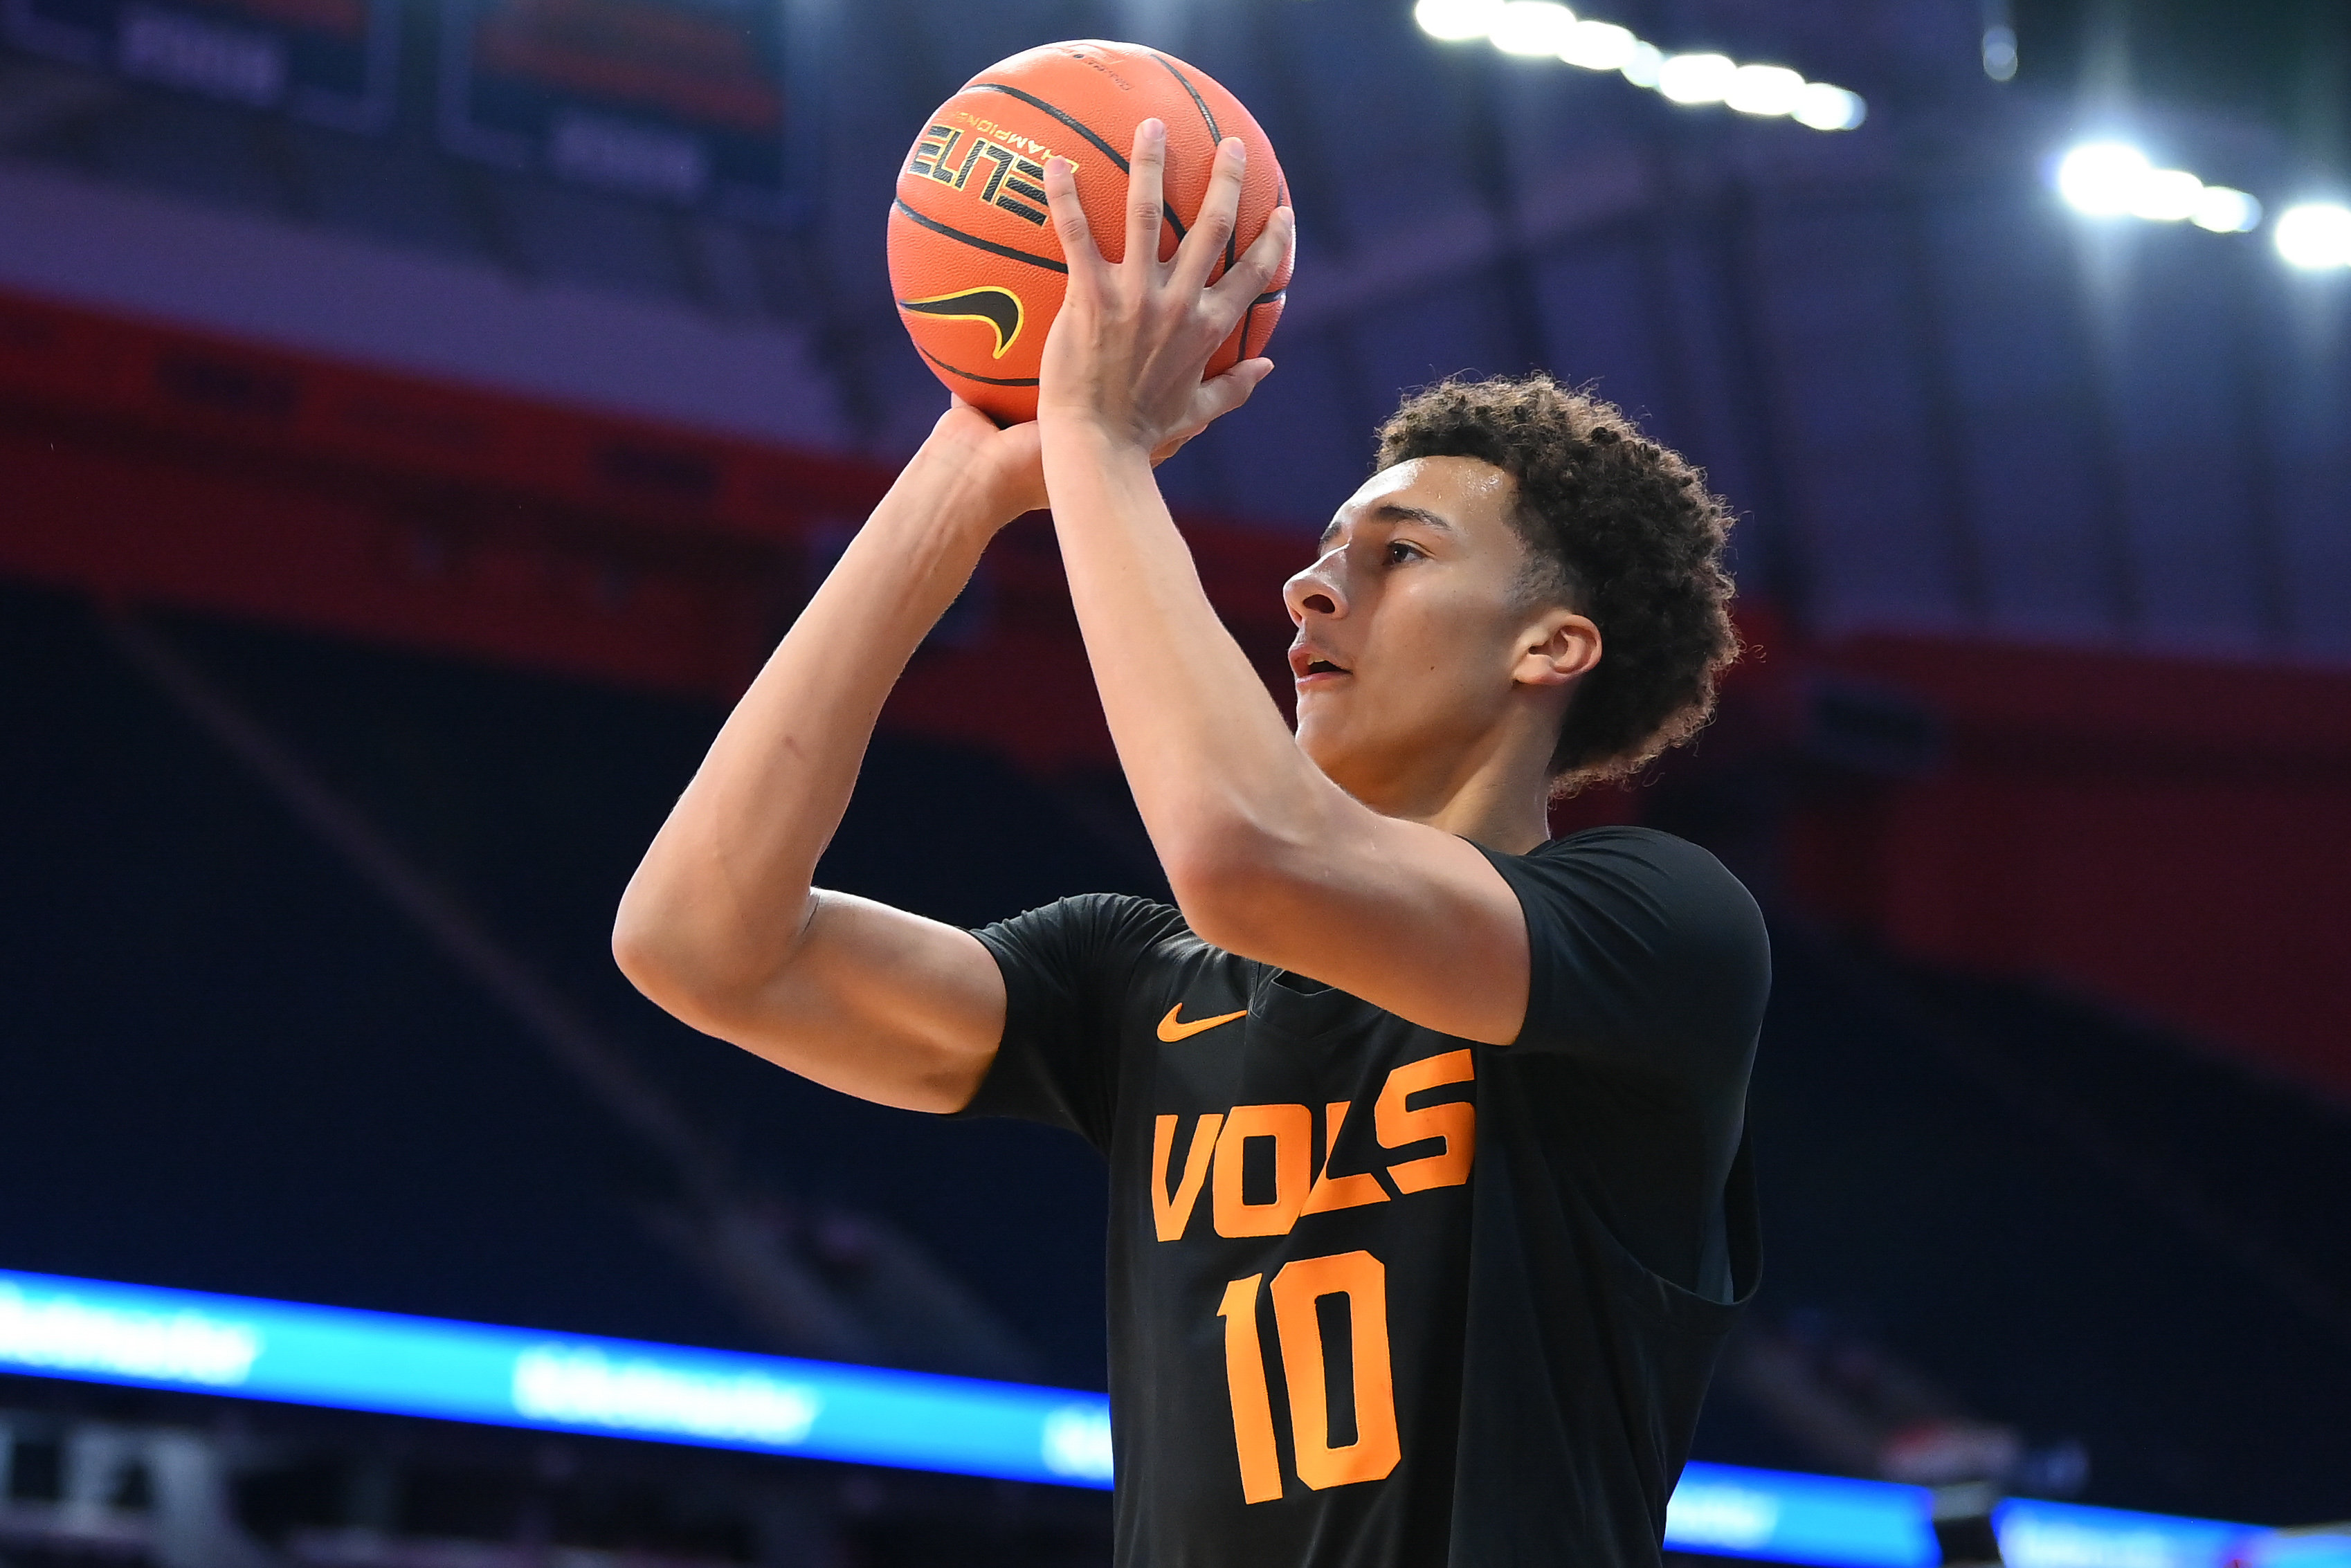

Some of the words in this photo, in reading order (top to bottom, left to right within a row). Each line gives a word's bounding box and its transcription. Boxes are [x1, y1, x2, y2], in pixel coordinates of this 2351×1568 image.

[906, 124, 1051, 230] ELITE
[1151, 1048, 1476, 1242] VOLS
[1216, 1250, 1401, 1504] 10
